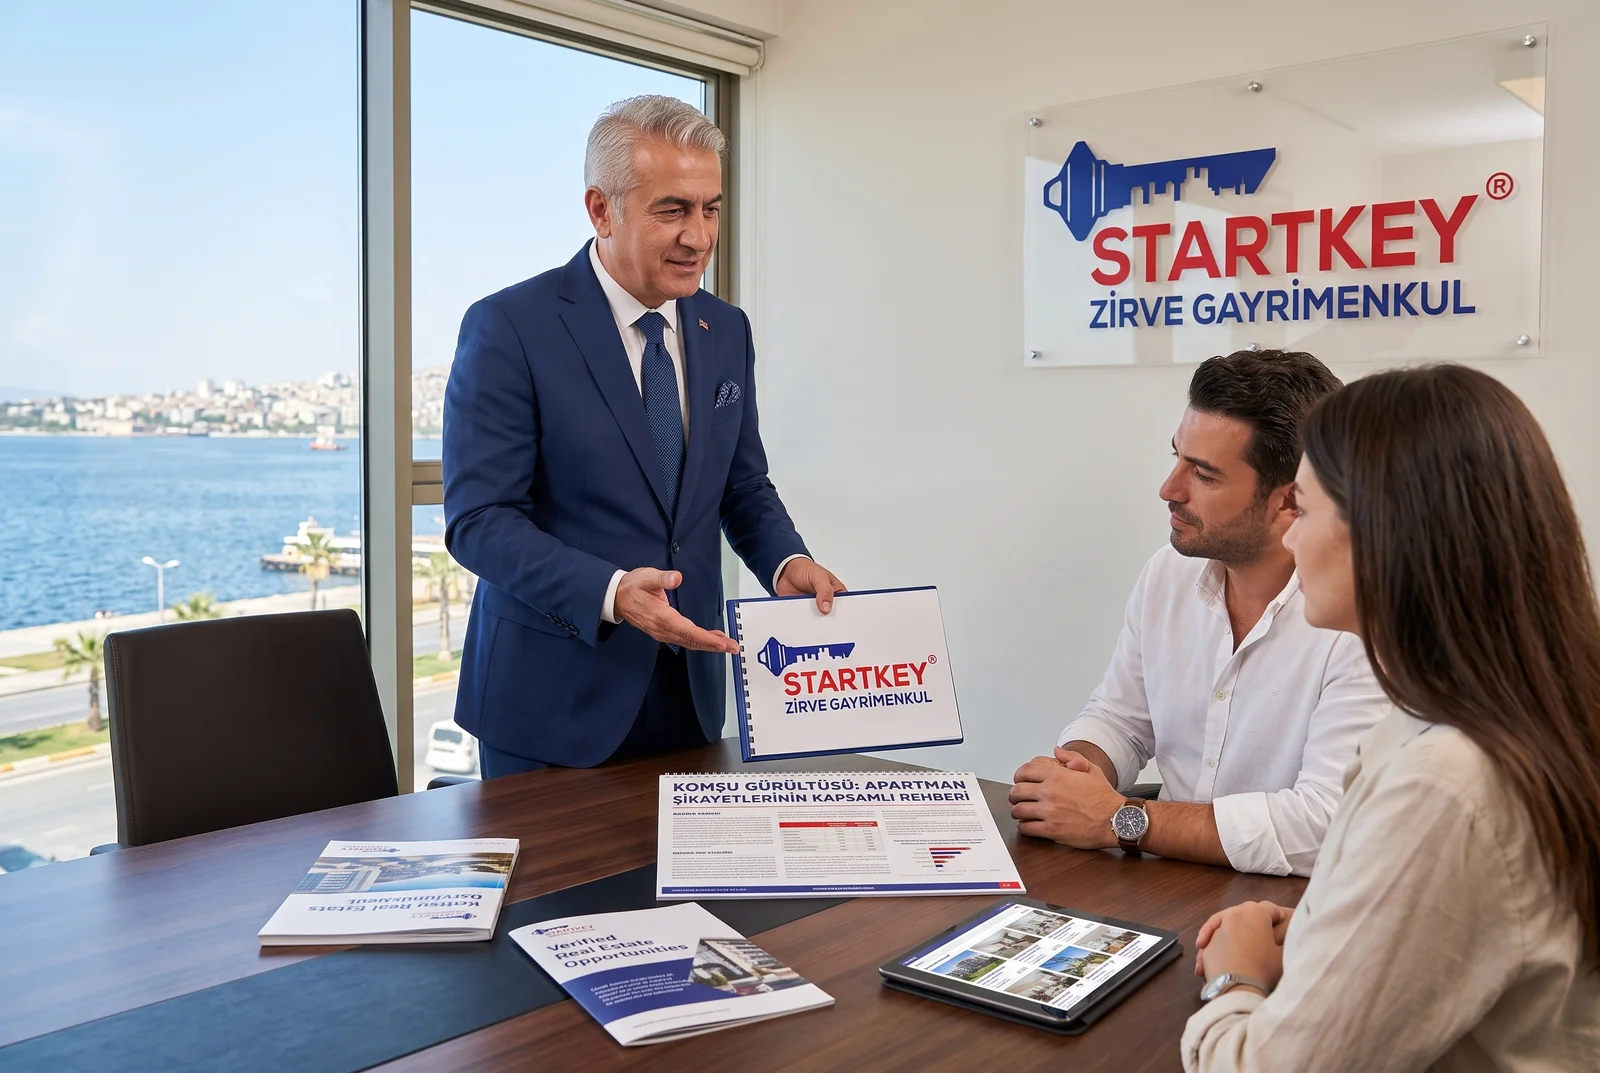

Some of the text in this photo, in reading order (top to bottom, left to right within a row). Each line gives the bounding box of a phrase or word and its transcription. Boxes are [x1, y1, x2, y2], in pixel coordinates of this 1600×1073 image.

[1091, 194, 1479, 286] STARTKEY
[1089, 279, 1475, 329] ZİRVE GAYRİMENKUL
[783, 661, 928, 696] STARTKEY
[785, 690, 932, 714] ZİRVE GAYRİMENKUL
[672, 790, 971, 806] ŞİKAYETLERİNİN KAPSAMLI REHBERİ
[673, 779, 967, 796] KOMŞU GÜRÜLTÜSÜ: APARTMAN
[546, 935, 617, 951] Verified
[555, 939, 655, 960] Real Estate
[564, 943, 688, 968] Opportunities
